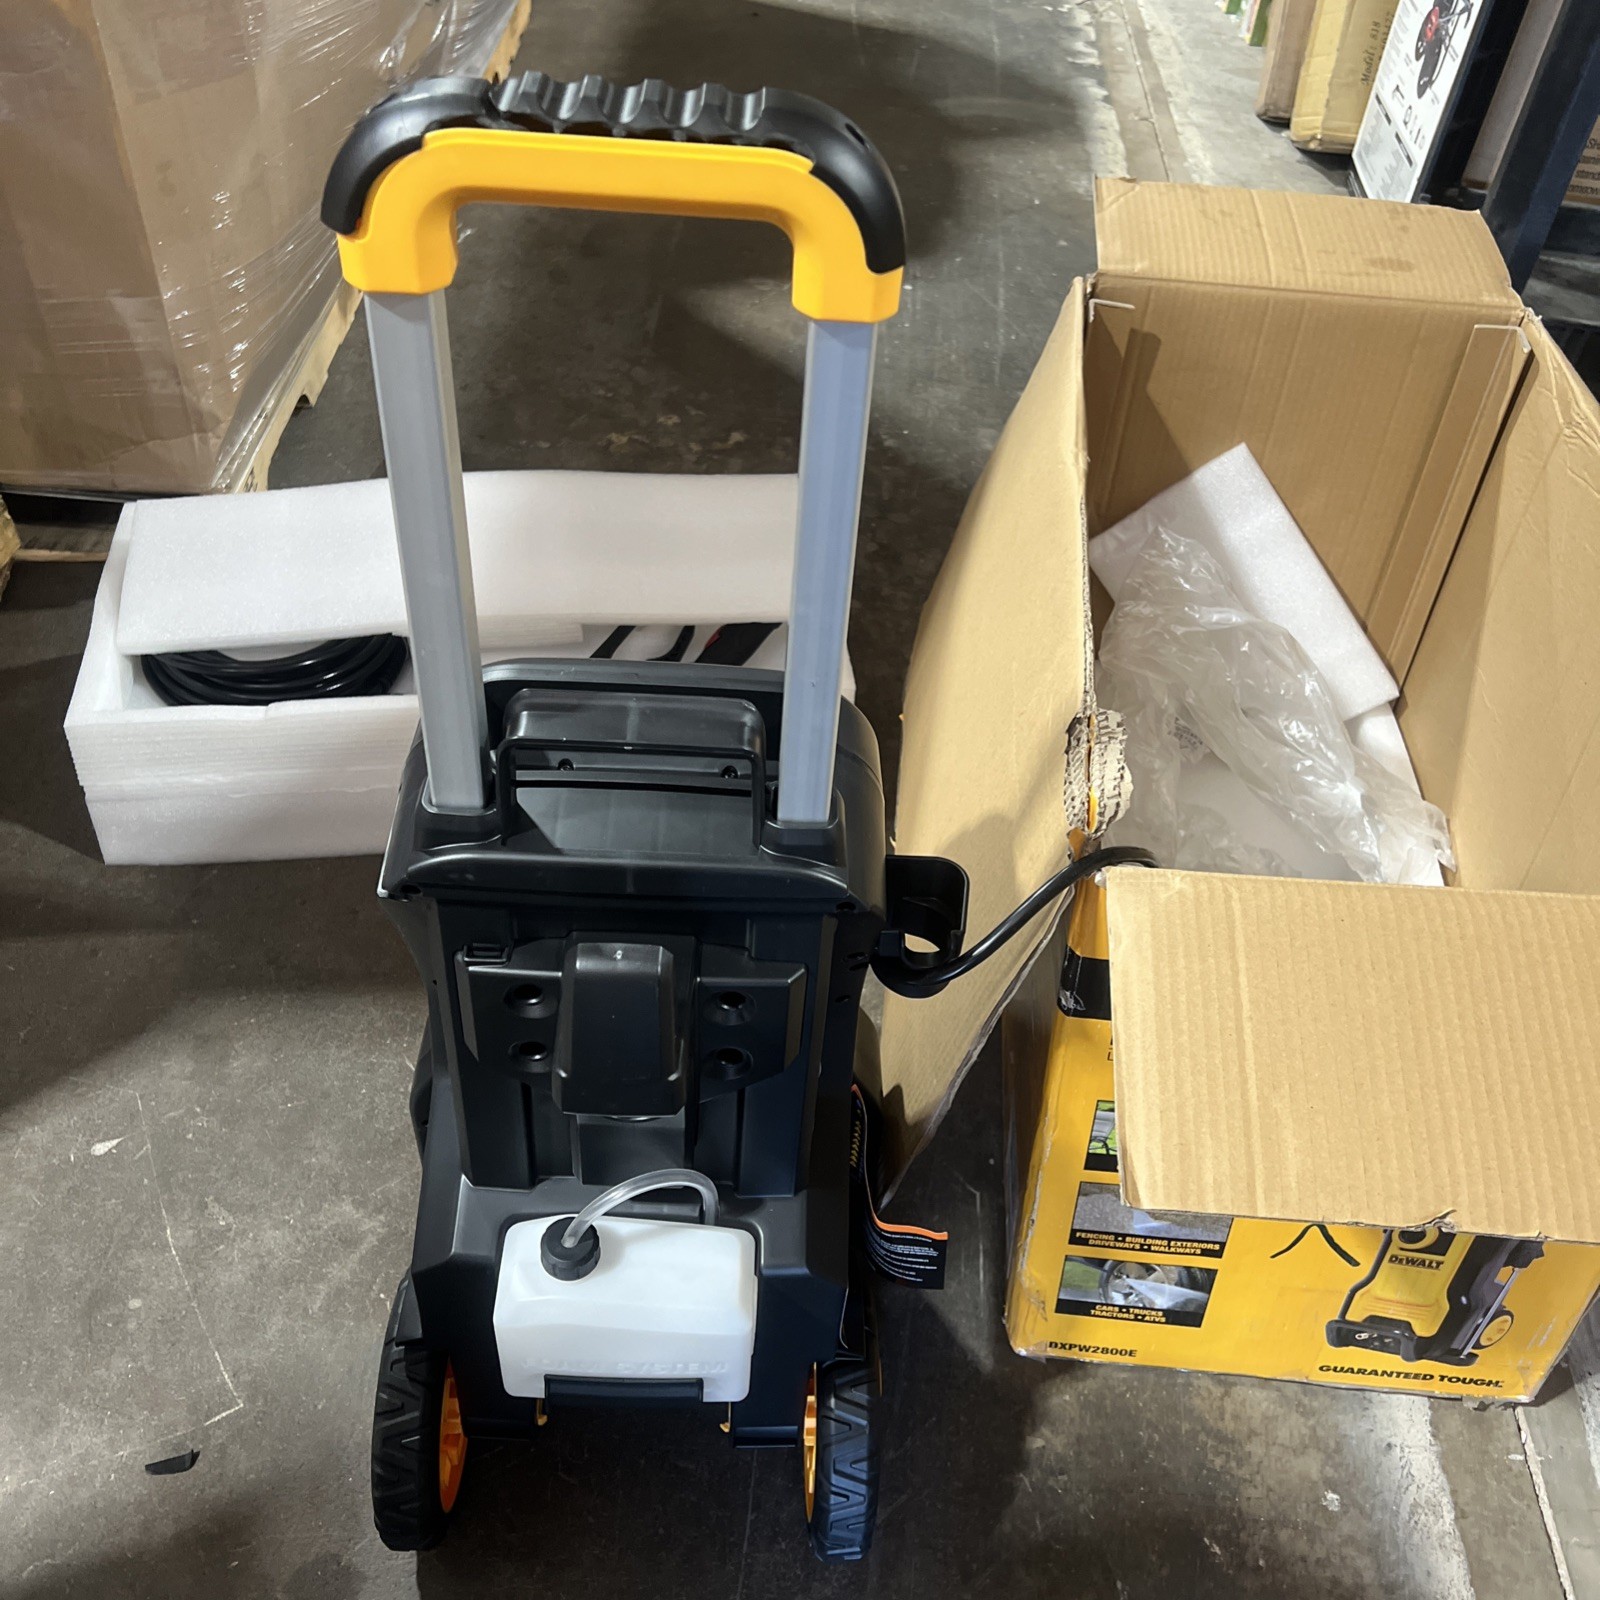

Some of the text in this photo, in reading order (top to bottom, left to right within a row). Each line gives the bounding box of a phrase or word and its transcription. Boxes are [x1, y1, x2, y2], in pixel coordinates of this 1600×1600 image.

[1075, 1232, 1220, 1251] FENCING BUILDING EXTERIORS
[1088, 1239, 1202, 1255] DRIVEWAYS WALKWAYS
[1090, 1309, 1135, 1320] TRACTORS
[1129, 1308, 1163, 1316] TRUCKS
[1318, 1365, 1435, 1381] GUARANTEED
